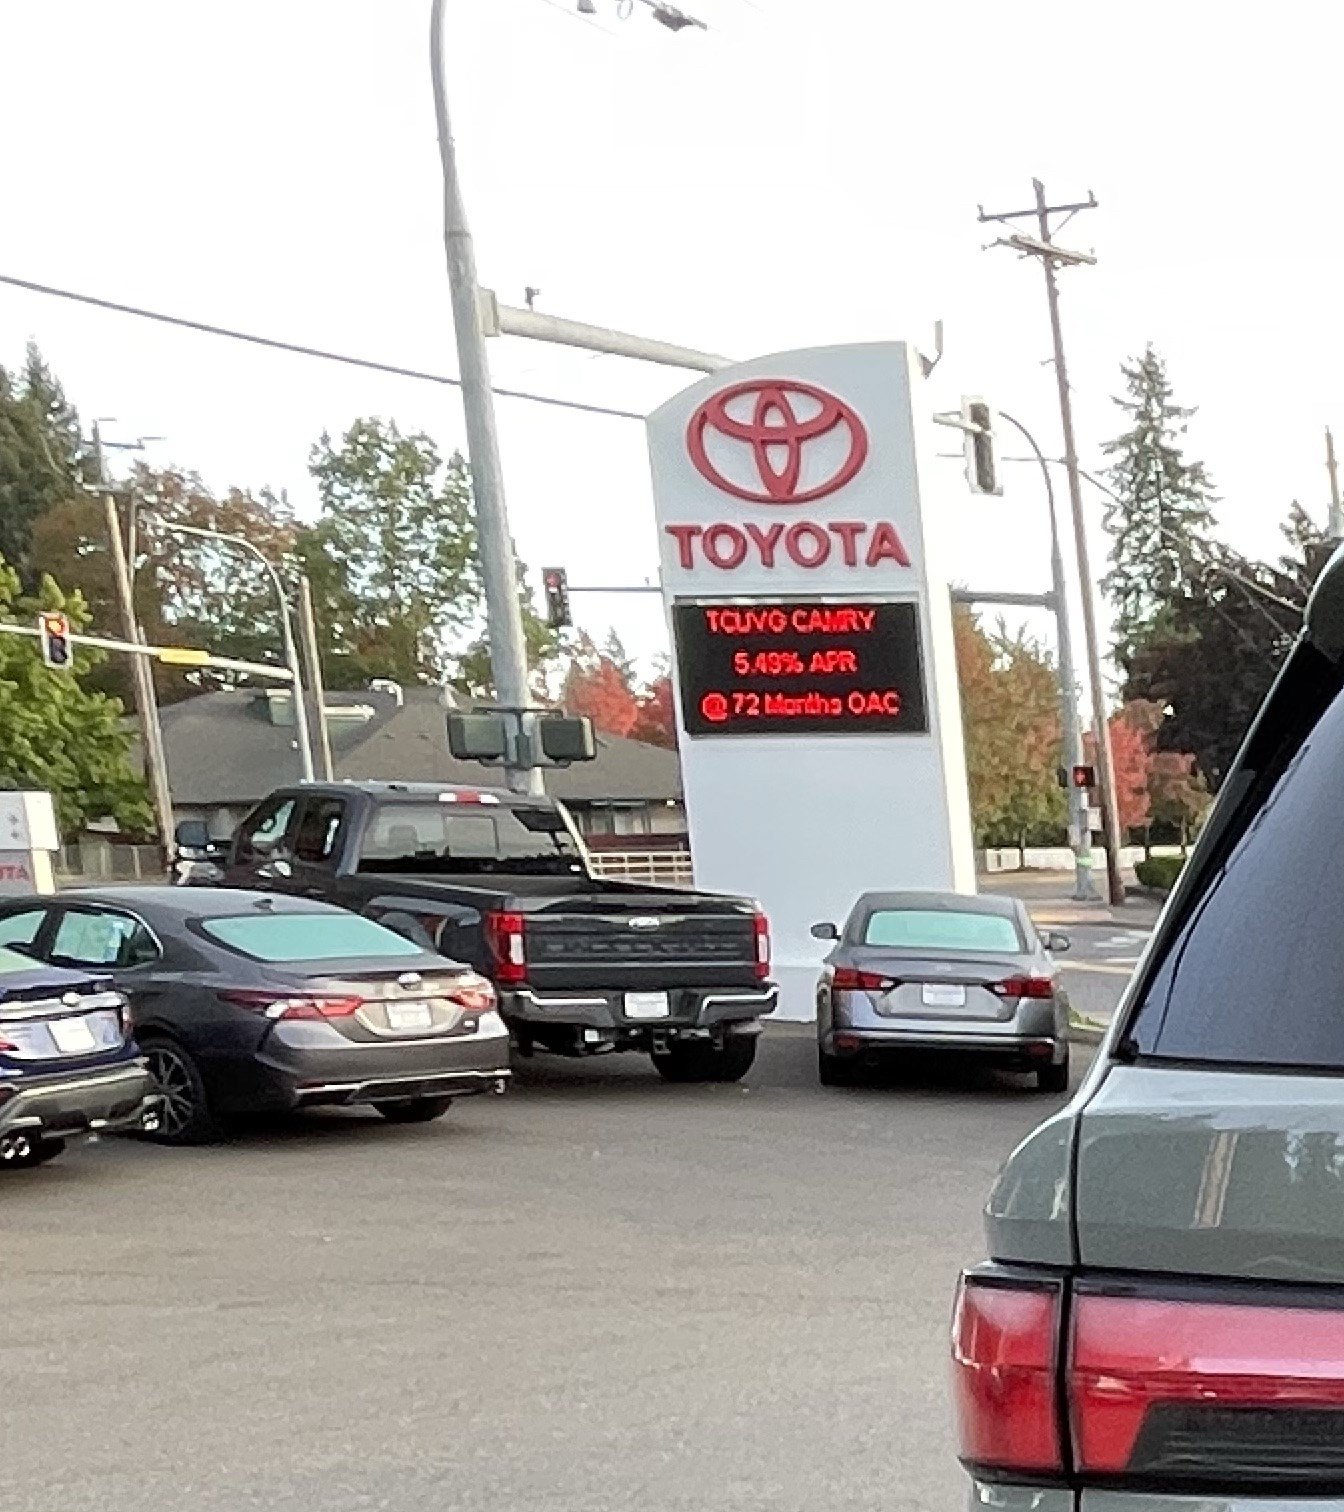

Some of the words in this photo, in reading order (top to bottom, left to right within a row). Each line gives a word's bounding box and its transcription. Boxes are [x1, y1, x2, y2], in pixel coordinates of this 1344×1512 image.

[665, 521, 912, 571] TOYOTA
[791, 608, 877, 632] CAMRY
[810, 650, 859, 673] APR
[701, 692, 729, 721] @
[731, 692, 761, 716] 72
[764, 692, 843, 715] Months
[847, 690, 901, 715] OAC
